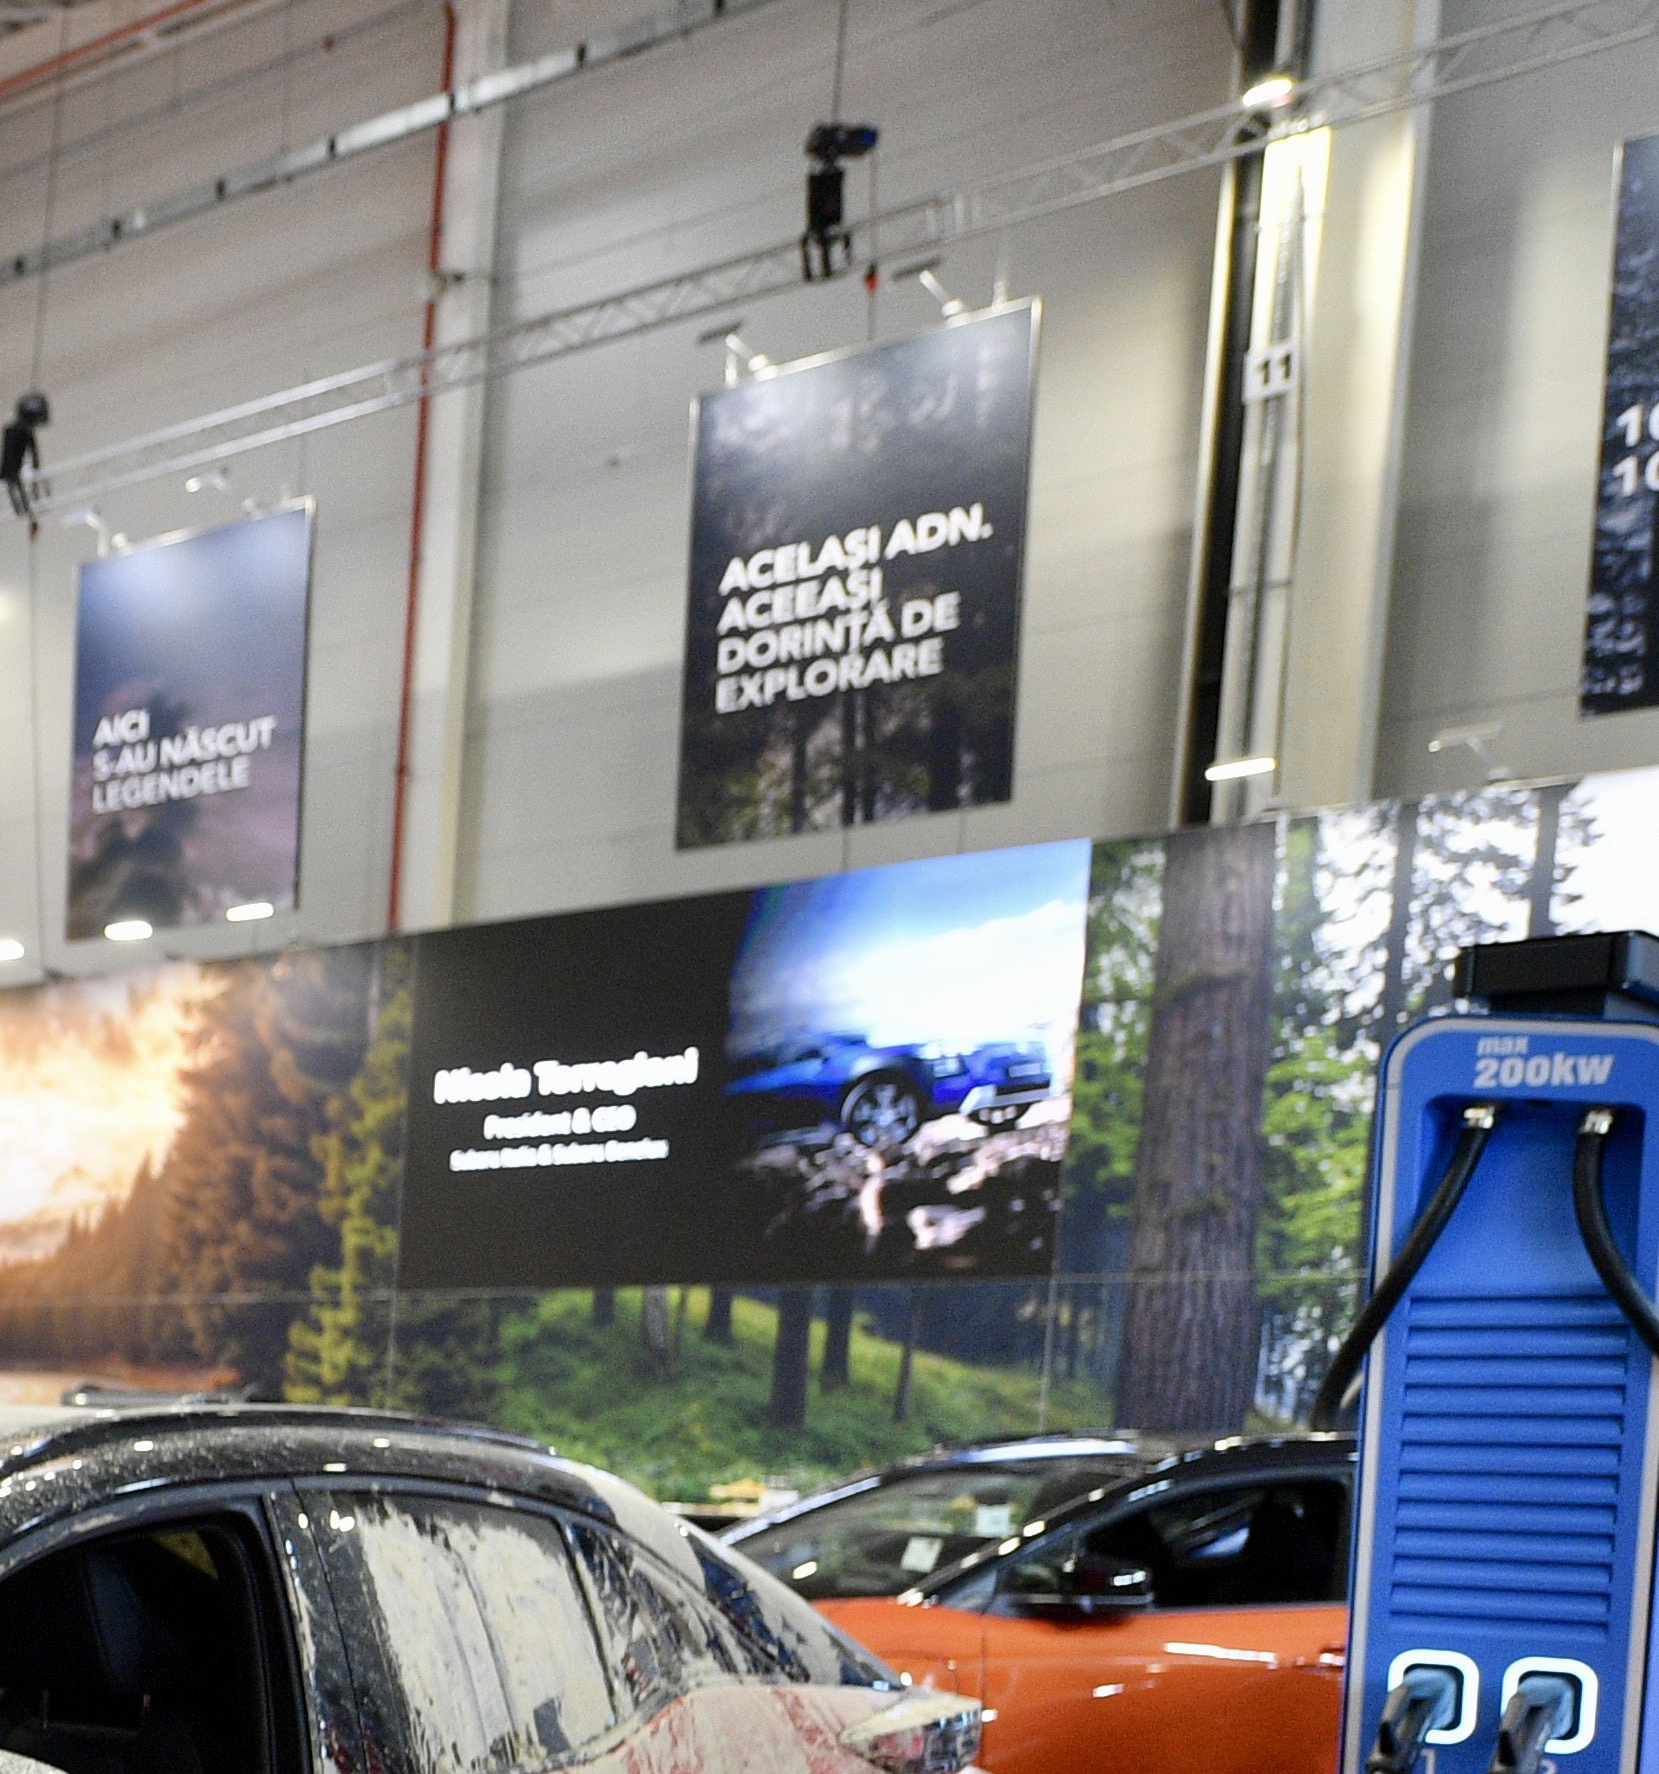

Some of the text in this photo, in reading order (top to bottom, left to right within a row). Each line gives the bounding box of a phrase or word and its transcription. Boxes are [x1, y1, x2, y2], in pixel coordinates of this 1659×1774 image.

[1255, 352, 1291, 386] 11
[883, 502, 994, 561] ADN.
[900, 591, 962, 639] DE
[715, 637, 945, 714] EXPLORARE
[92, 706, 151, 749] AICI
[91, 754, 251, 815] LEGENDELE
[1476, 1035, 1530, 1056] max
